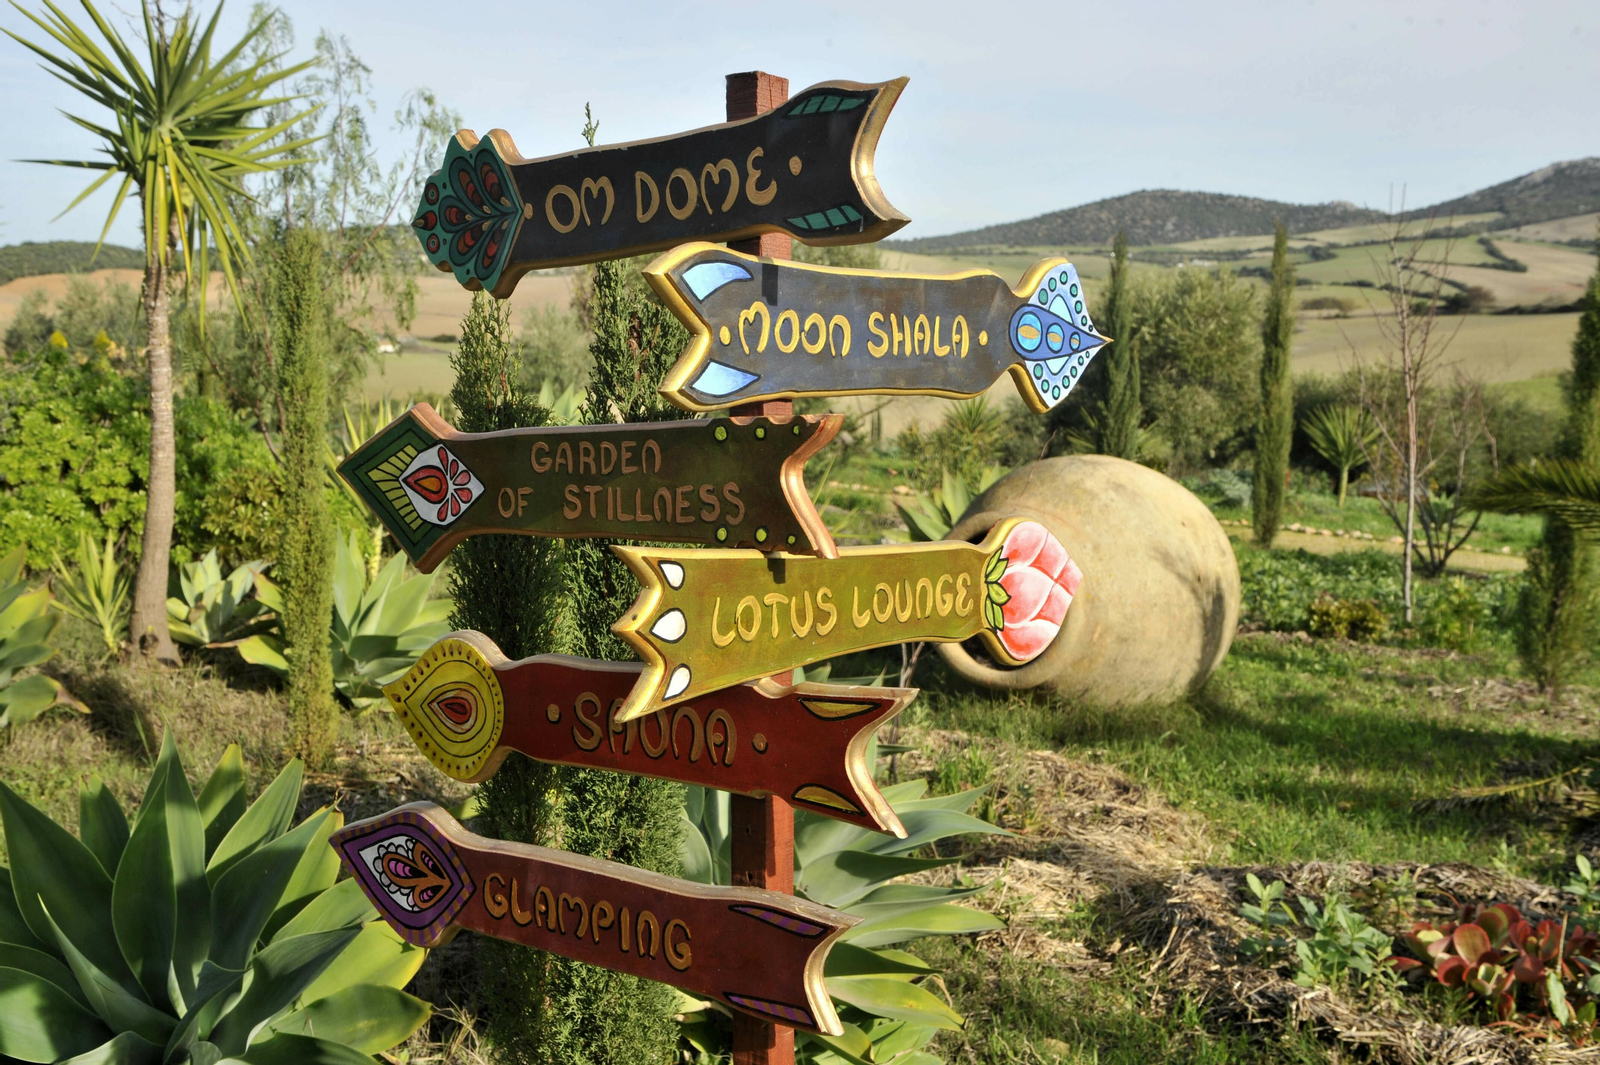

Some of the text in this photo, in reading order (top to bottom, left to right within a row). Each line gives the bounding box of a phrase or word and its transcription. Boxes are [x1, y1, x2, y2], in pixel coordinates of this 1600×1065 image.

[546, 147, 778, 233] OM DOME
[739, 301, 970, 358] MOON SHALA
[531, 440, 662, 475] GARDEN
[499, 482, 746, 524] OF STILLNESS
[712, 573, 975, 648] LOTUS LOUNGE
[573, 692, 737, 766] SAUNA
[484, 873, 693, 971] GLAMPING
